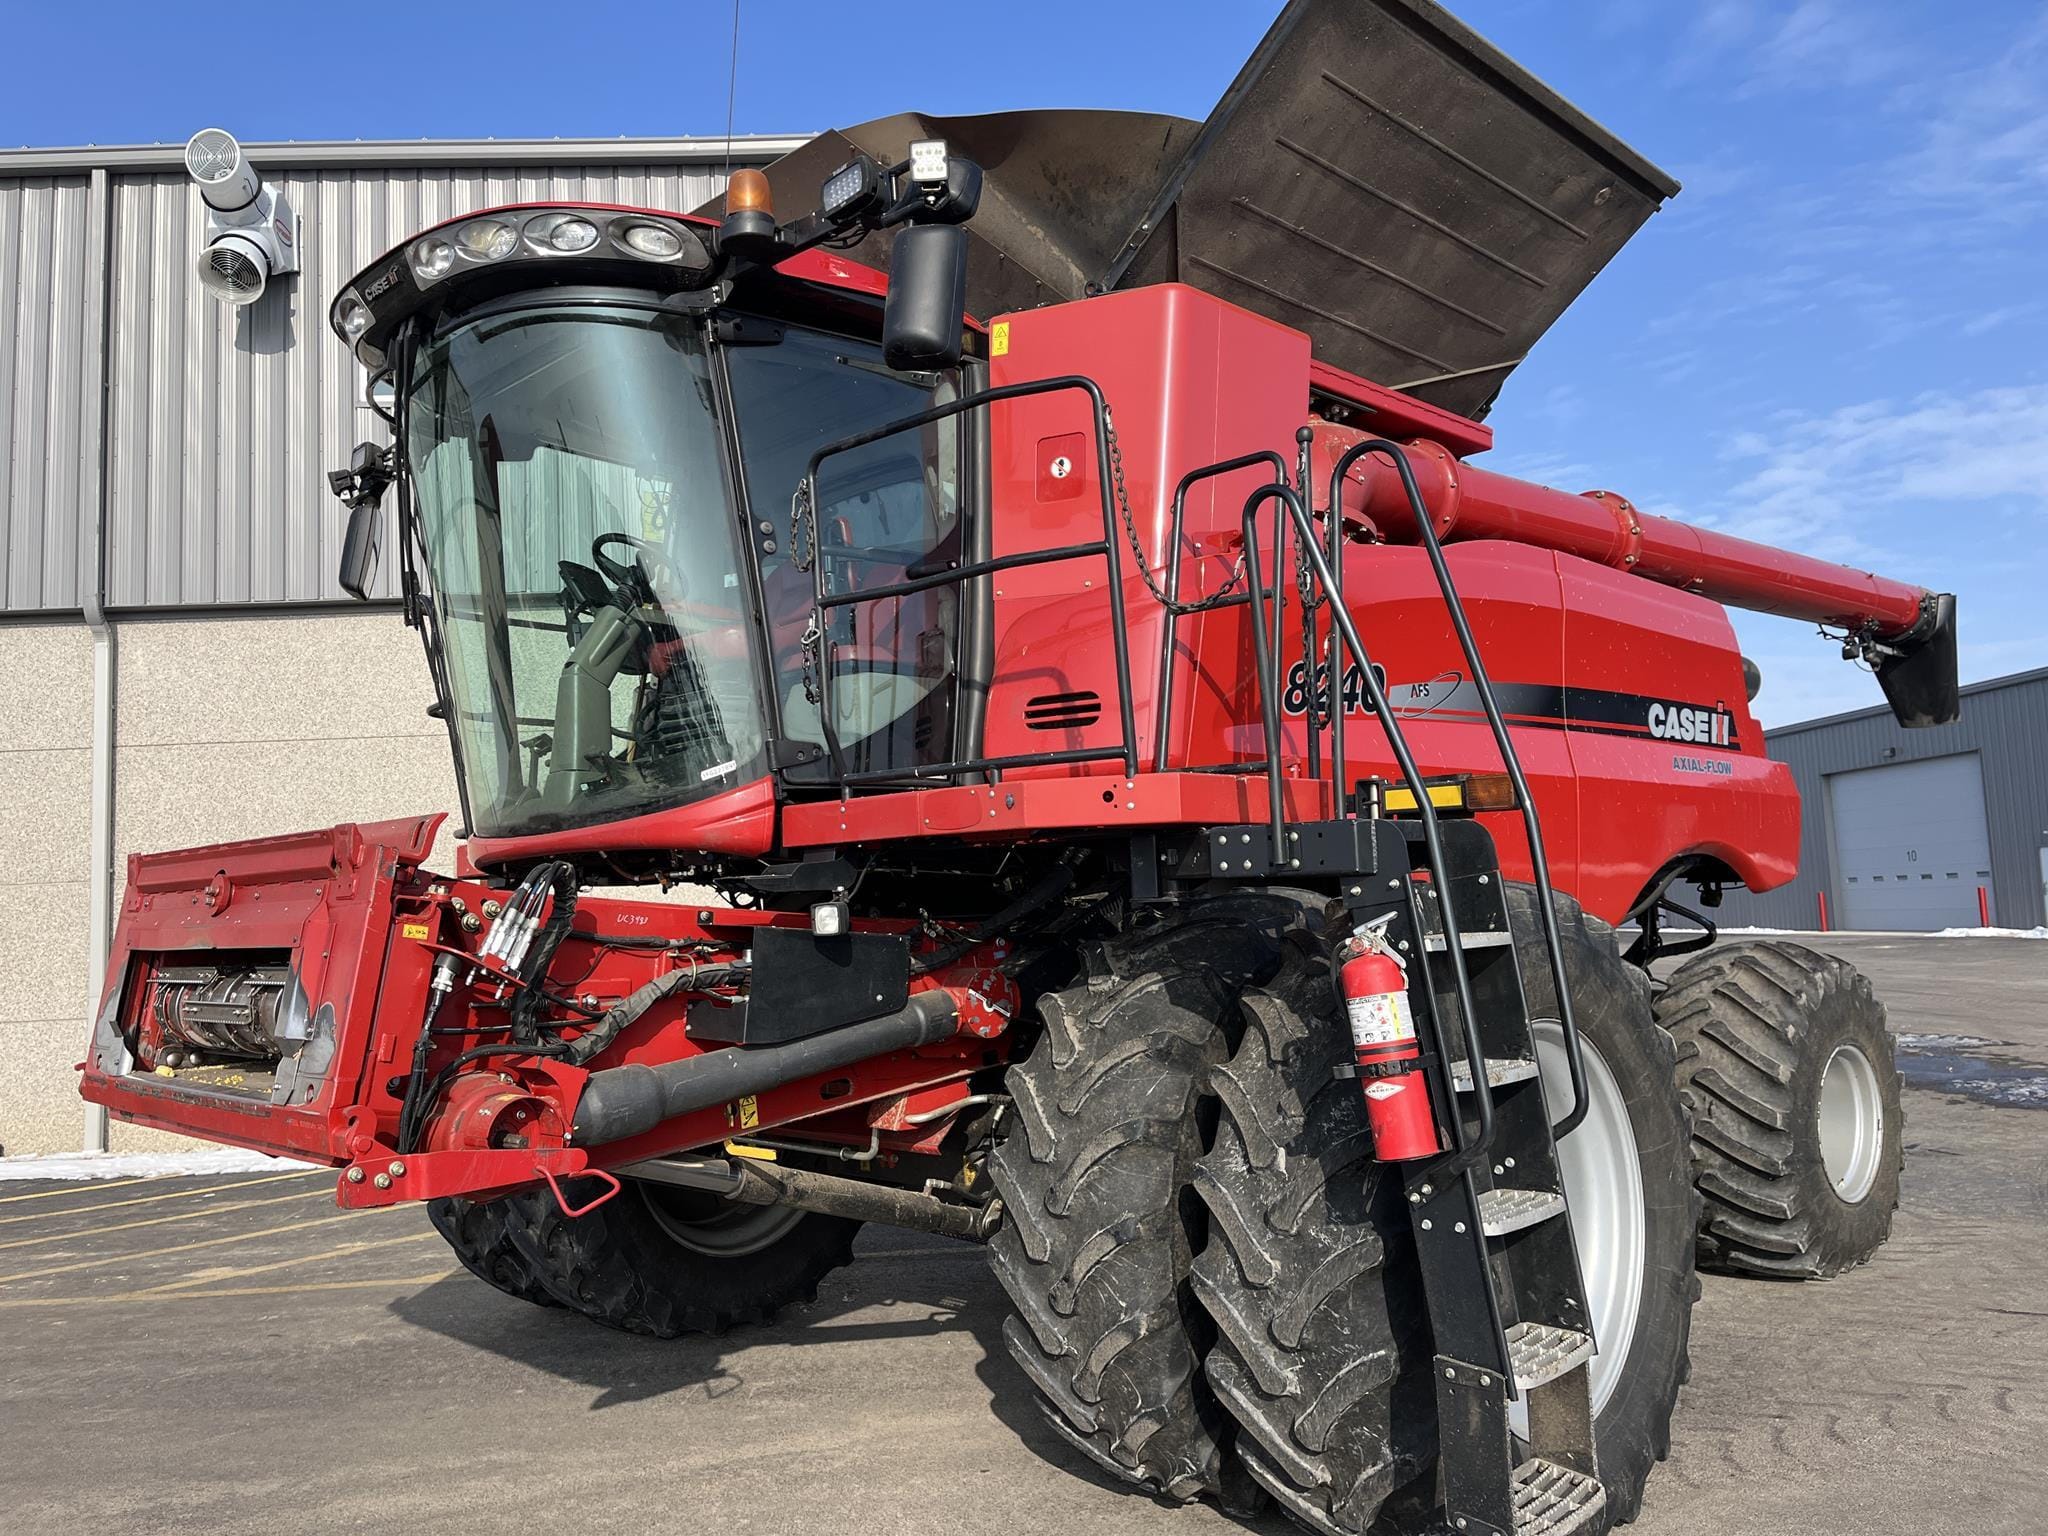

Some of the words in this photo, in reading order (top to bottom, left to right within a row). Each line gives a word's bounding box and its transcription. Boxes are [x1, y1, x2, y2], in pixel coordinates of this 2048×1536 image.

[365, 276, 391, 300] CASE
[1410, 683, 1430, 698] AFS
[1672, 756, 1732, 775] AXIAL-FLOW
[1906, 849, 1918, 862] 10
